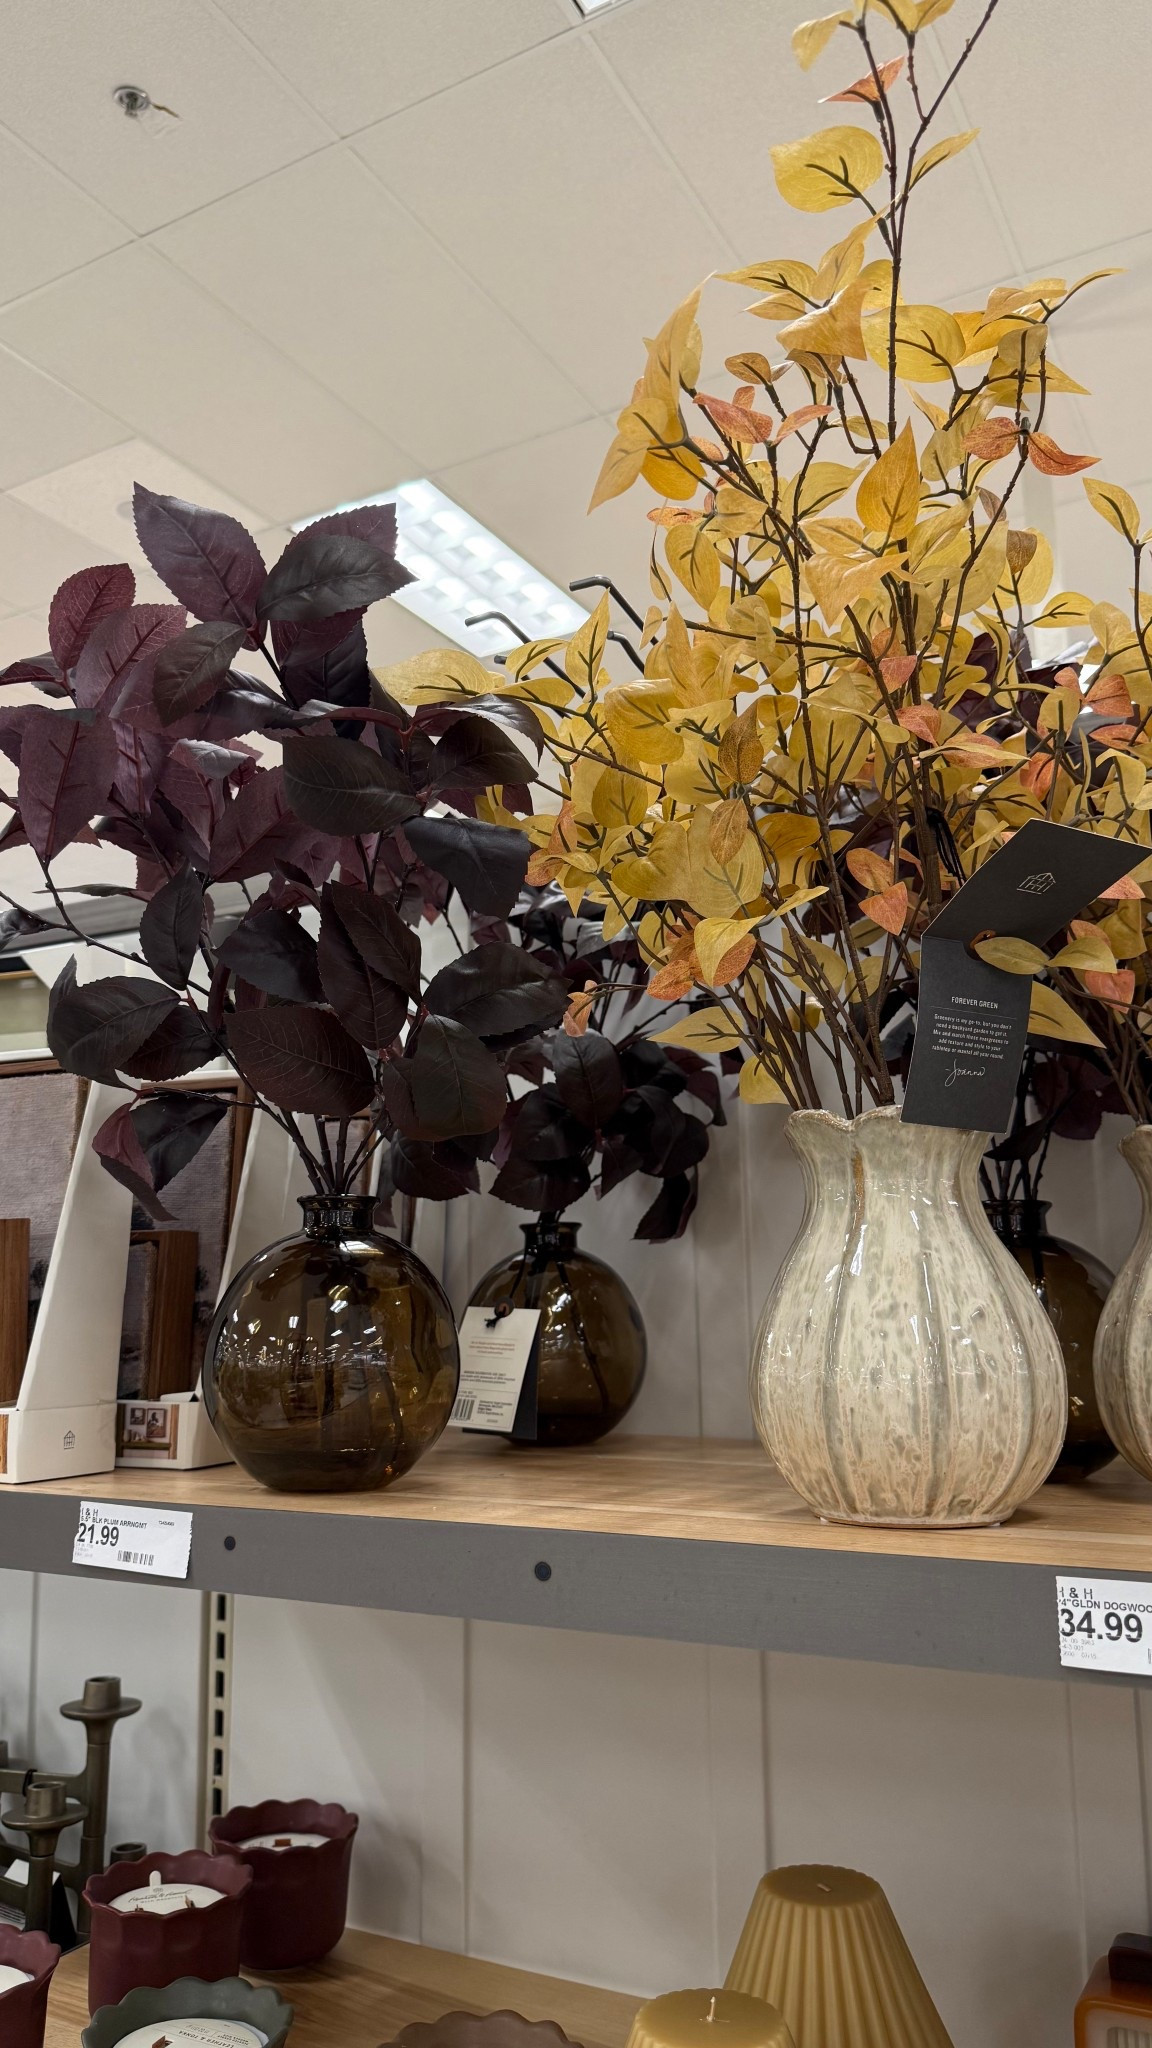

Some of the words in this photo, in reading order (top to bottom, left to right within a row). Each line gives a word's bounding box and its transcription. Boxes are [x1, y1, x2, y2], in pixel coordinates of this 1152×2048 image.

[951, 996, 978, 1006] FOREVER
[978, 1000, 999, 1009] GREEN
[934, 1013, 955, 1022] Greenery
[932, 1045, 951, 1053] tabletop
[948, 1039, 964, 1047] texture
[85, 1508, 91, 1516] &
[92, 1508, 99, 1517] H
[92, 1516, 103, 1524] BLK
[103, 1518, 119, 1526] PLUM
[119, 1520, 148, 1530] ARRNGMT
[76, 1522, 120, 1547] 21.99
[1069, 1587, 1079, 1599] &
[1083, 1588, 1093, 1600] H
[1060, 1608, 1143, 1643] 34.99
